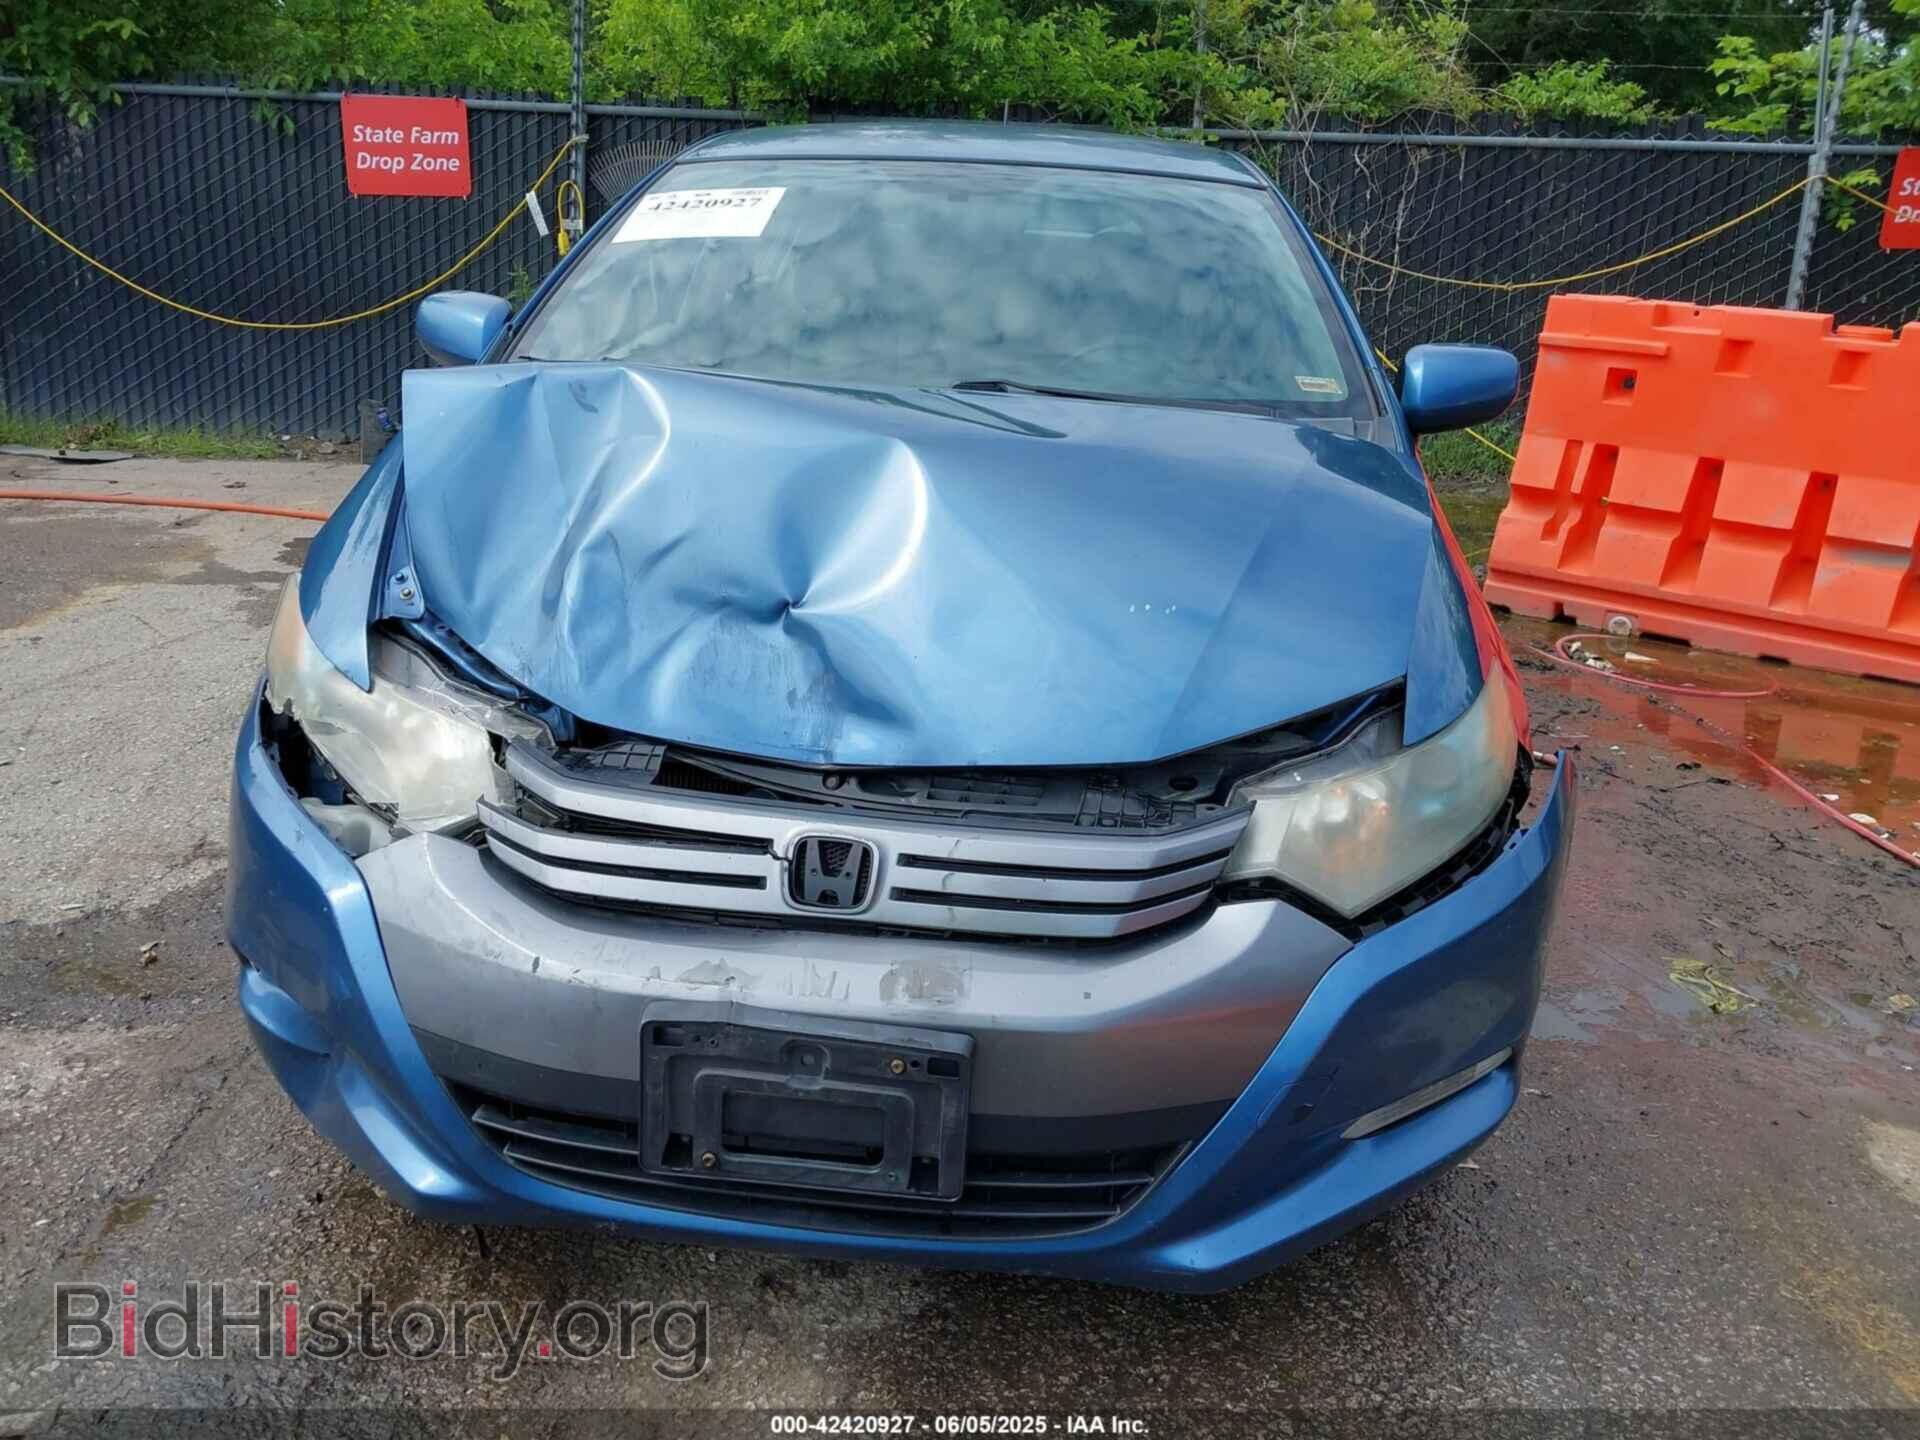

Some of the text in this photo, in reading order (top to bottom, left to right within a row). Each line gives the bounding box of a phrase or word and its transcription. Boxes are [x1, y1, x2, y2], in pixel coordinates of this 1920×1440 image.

[352, 125, 459, 145] State Farm
[356, 152, 460, 174] Drop Zone
